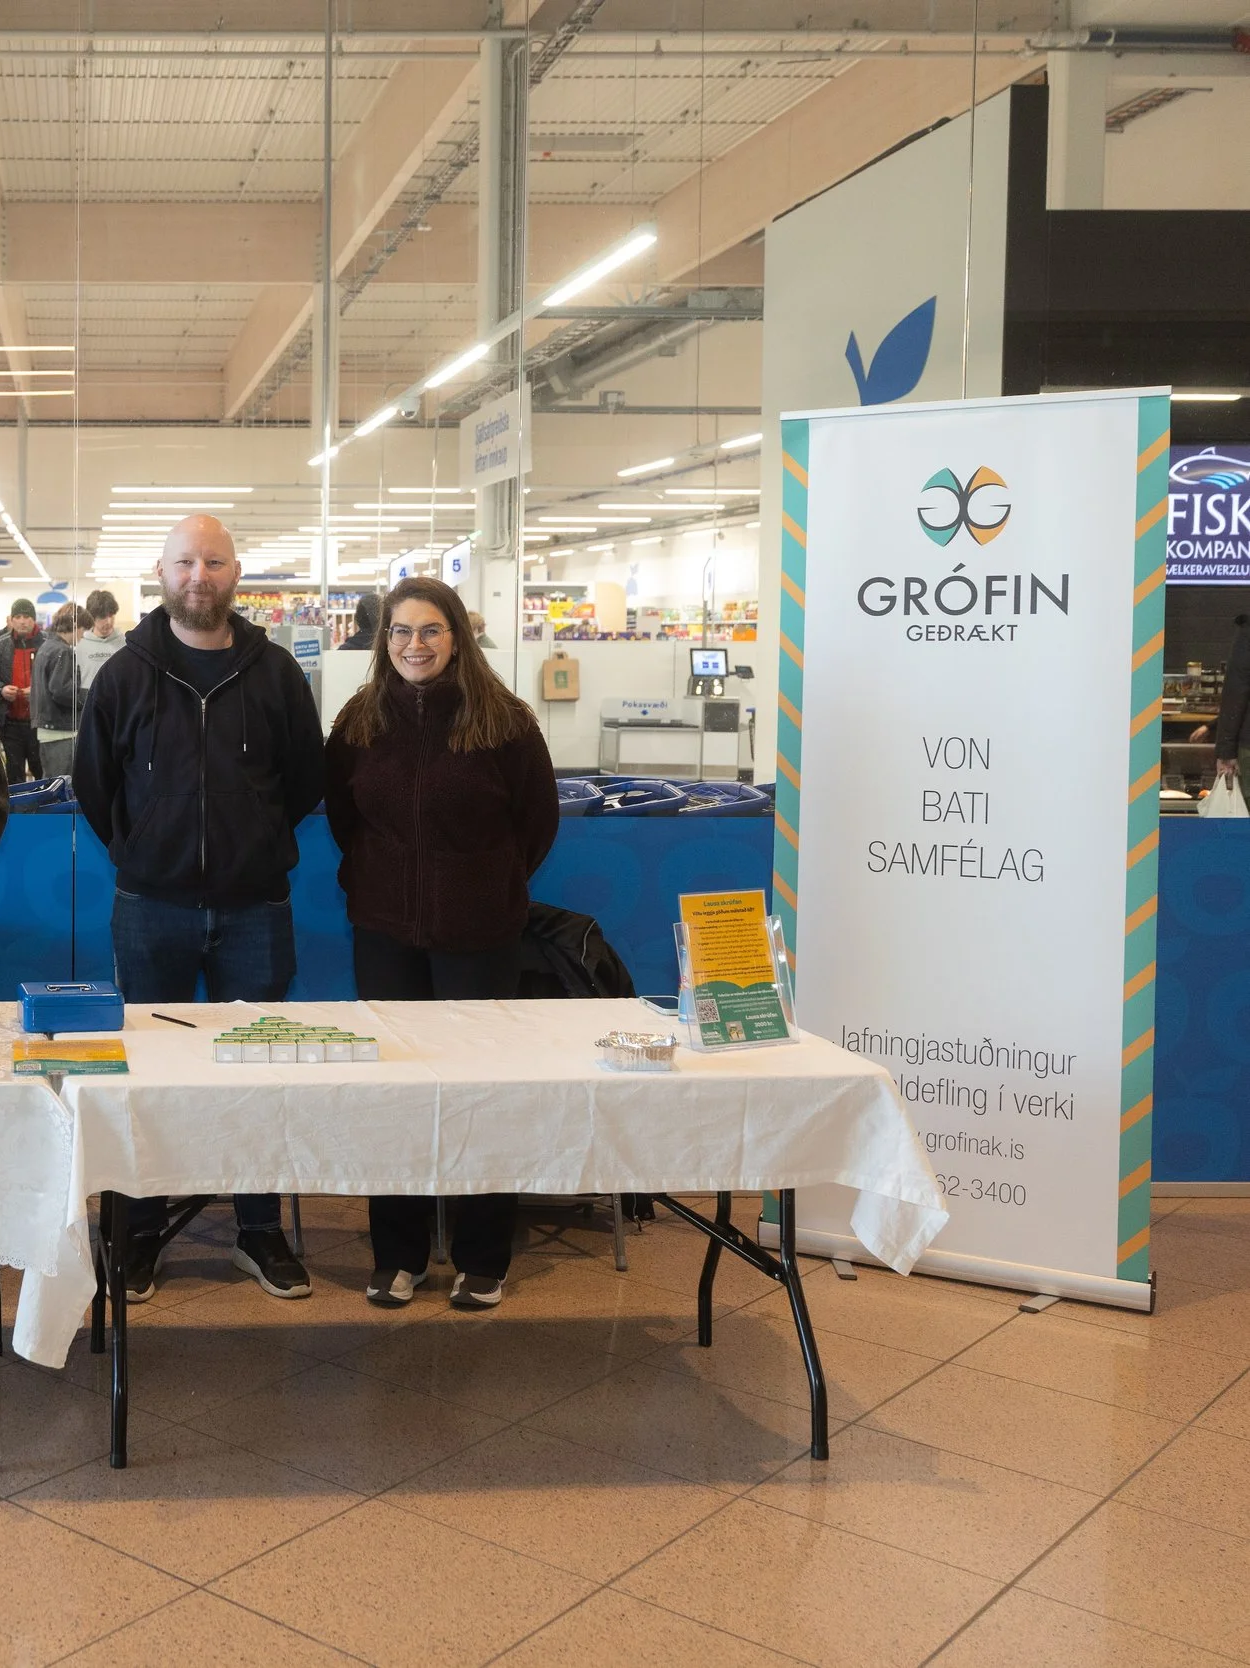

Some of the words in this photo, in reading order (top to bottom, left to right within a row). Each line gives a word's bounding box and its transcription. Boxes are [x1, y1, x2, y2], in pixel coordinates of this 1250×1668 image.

[452, 559, 462, 573] 5
[1166, 540, 1250, 560] KOMPAN
[399, 567, 407, 577] 4
[857, 562, 1070, 617] GRÓFIN
[906, 624, 1018, 642] GEÐRÆKT
[922, 736, 991, 770] VON
[922, 790, 989, 825] BATI
[867, 838, 1044, 882] SAMFÉLAG
[833, 1025, 1077, 1079] Jafningjastuðningur
[893, 1073, 988, 1116] ldefling
[999, 1084, 1005, 1112] í
[1014, 1091, 1074, 1121] verki
[934, 1173, 1027, 1206] 62-3400
